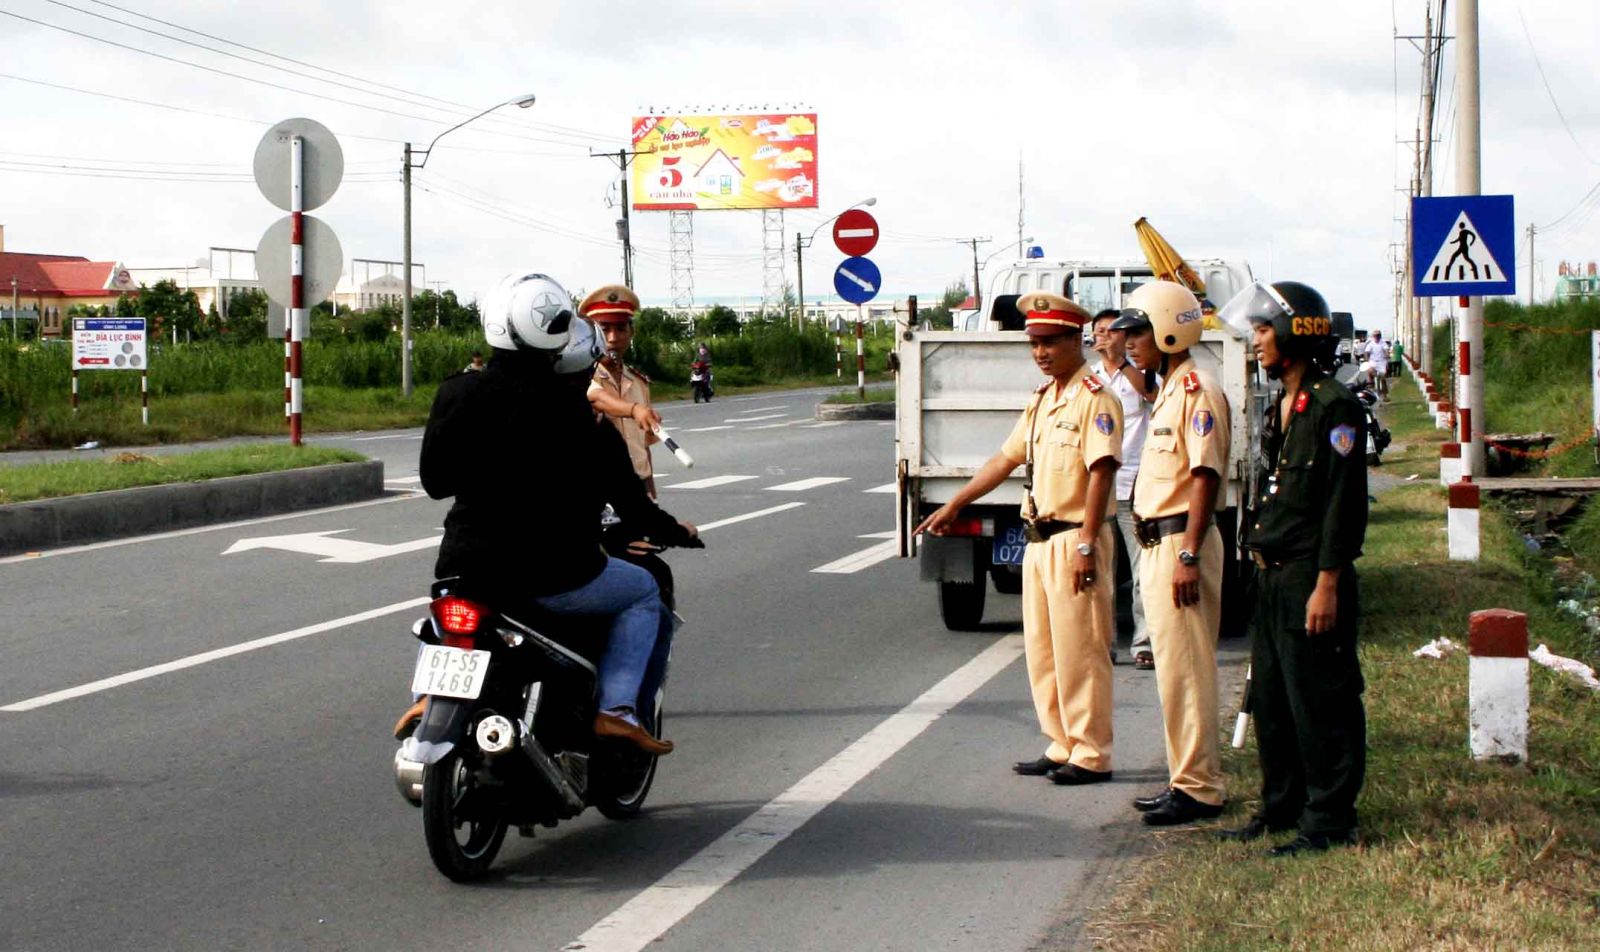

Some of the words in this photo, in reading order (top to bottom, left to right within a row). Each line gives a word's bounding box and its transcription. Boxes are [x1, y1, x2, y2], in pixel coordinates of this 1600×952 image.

[660, 156, 682, 188] 5
[430, 650, 481, 673] 61-S5
[427, 671, 474, 694] 1469
